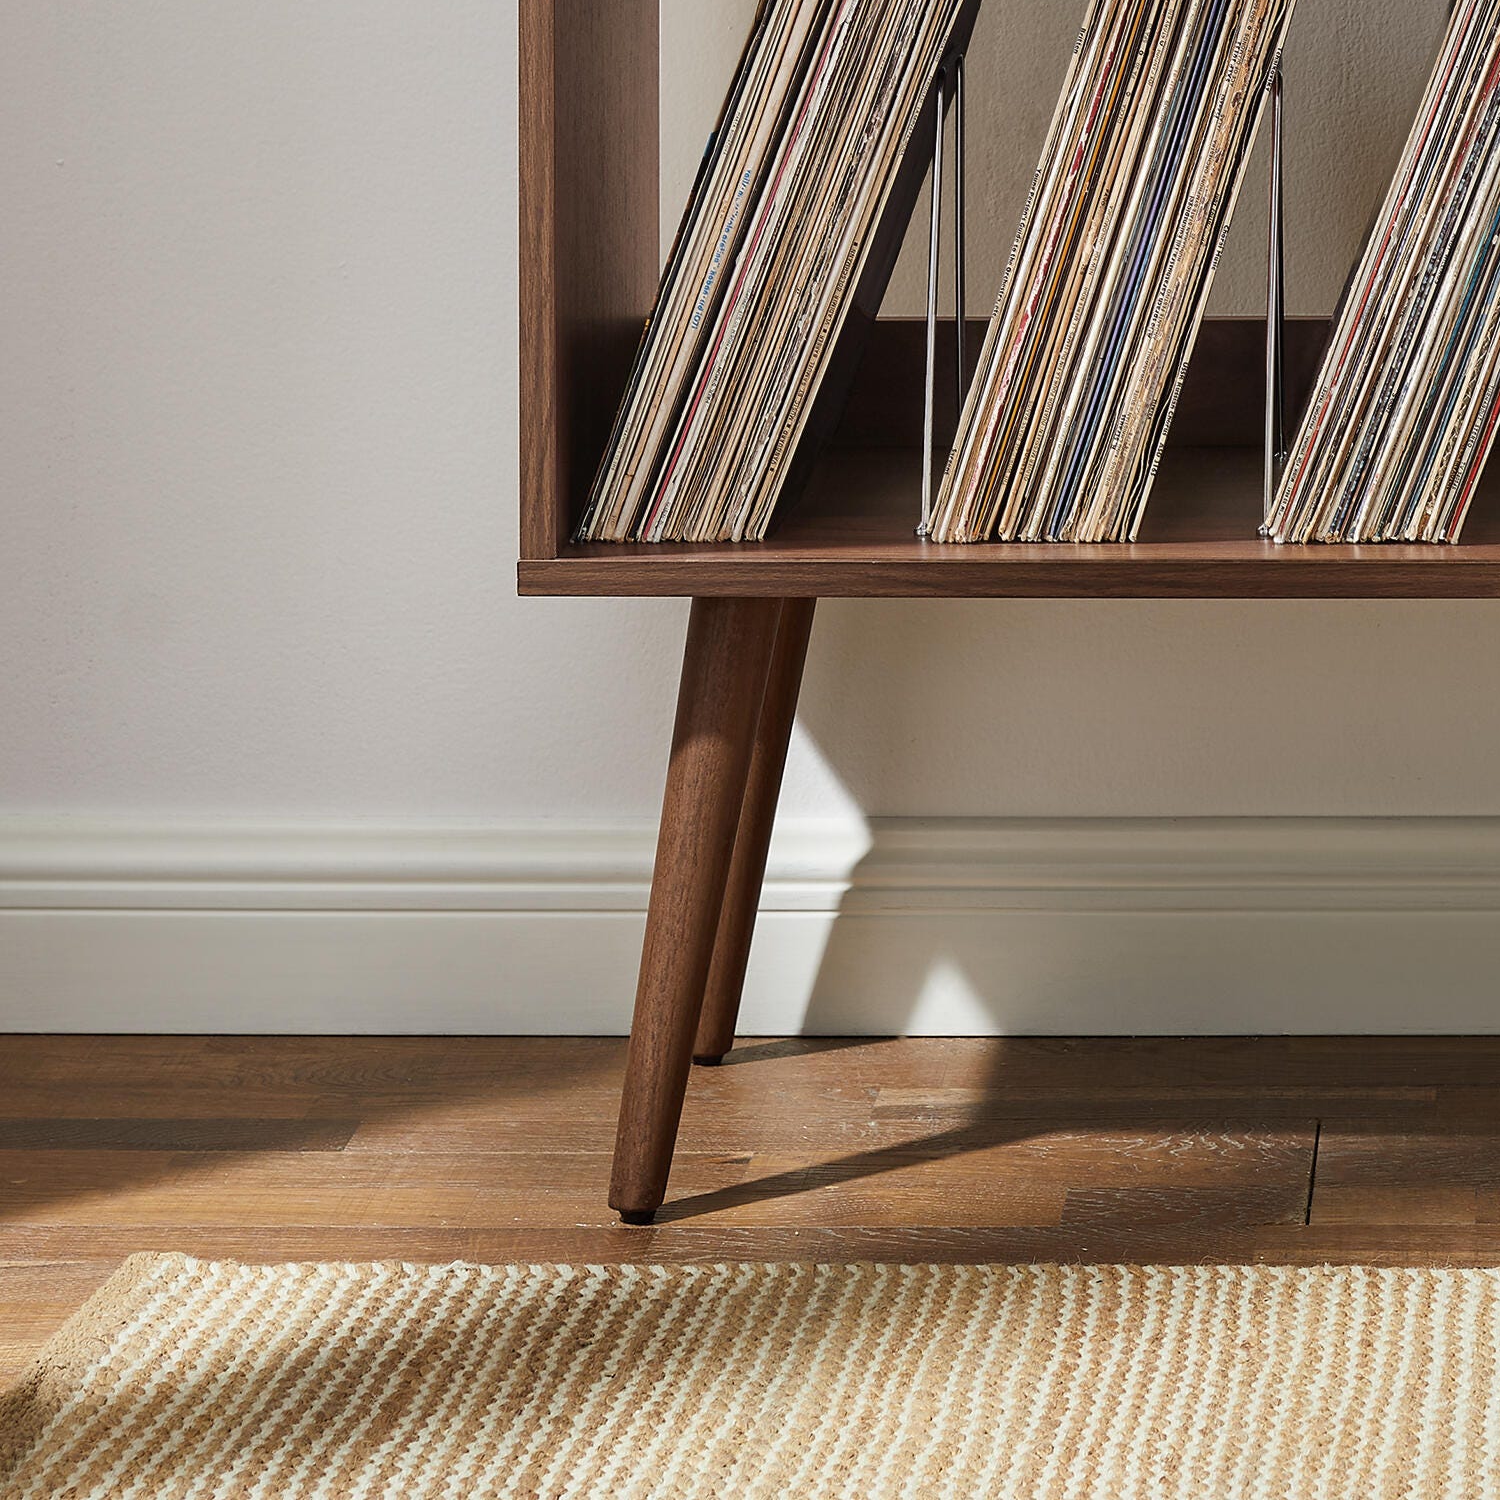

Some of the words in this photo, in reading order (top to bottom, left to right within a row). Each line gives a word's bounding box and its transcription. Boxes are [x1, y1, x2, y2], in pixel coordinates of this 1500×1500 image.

[1073, 27, 1086, 55] Britten
[1235, 32, 1249, 65] DIAMONDS
[1233, 66, 1239, 74] OF
[1265, 46, 1282, 92] Tchaikovsky
[1116, 103, 1126, 124] DECCA
[1203, 138, 1217, 173] ORCHESTRA
[1193, 174, 1206, 208] SYMPHONY
[1020, 190, 1034, 221] Person's
[1187, 208, 1196, 225] STATE
[1014, 221, 1024, 242] Guide
[1176, 226, 1190, 261] HUNGARIAN
[1217, 223, 1229, 248] Choral
[1007, 252, 1015, 265] the
[1011, 243, 1018, 252] to
[1211, 250, 1222, 271] Music
[1152, 297, 1163, 321] sprach
[1160, 288, 1171, 311] FESTIVO
[771, 429, 788, 465] VANGUARD
[823, 293, 839, 325] VLADIMIR
[1178, 361, 1188, 379] USSR
[1169, 381, 1182, 409] Russian
[1476, 383, 1494, 420] TURNABOUT
[1161, 410, 1173, 436] Chorus
[1466, 424, 1479, 448] STEREO
[1155, 442, 1164, 458] ASD
[1104, 460, 1116, 486] SIBELIUS
